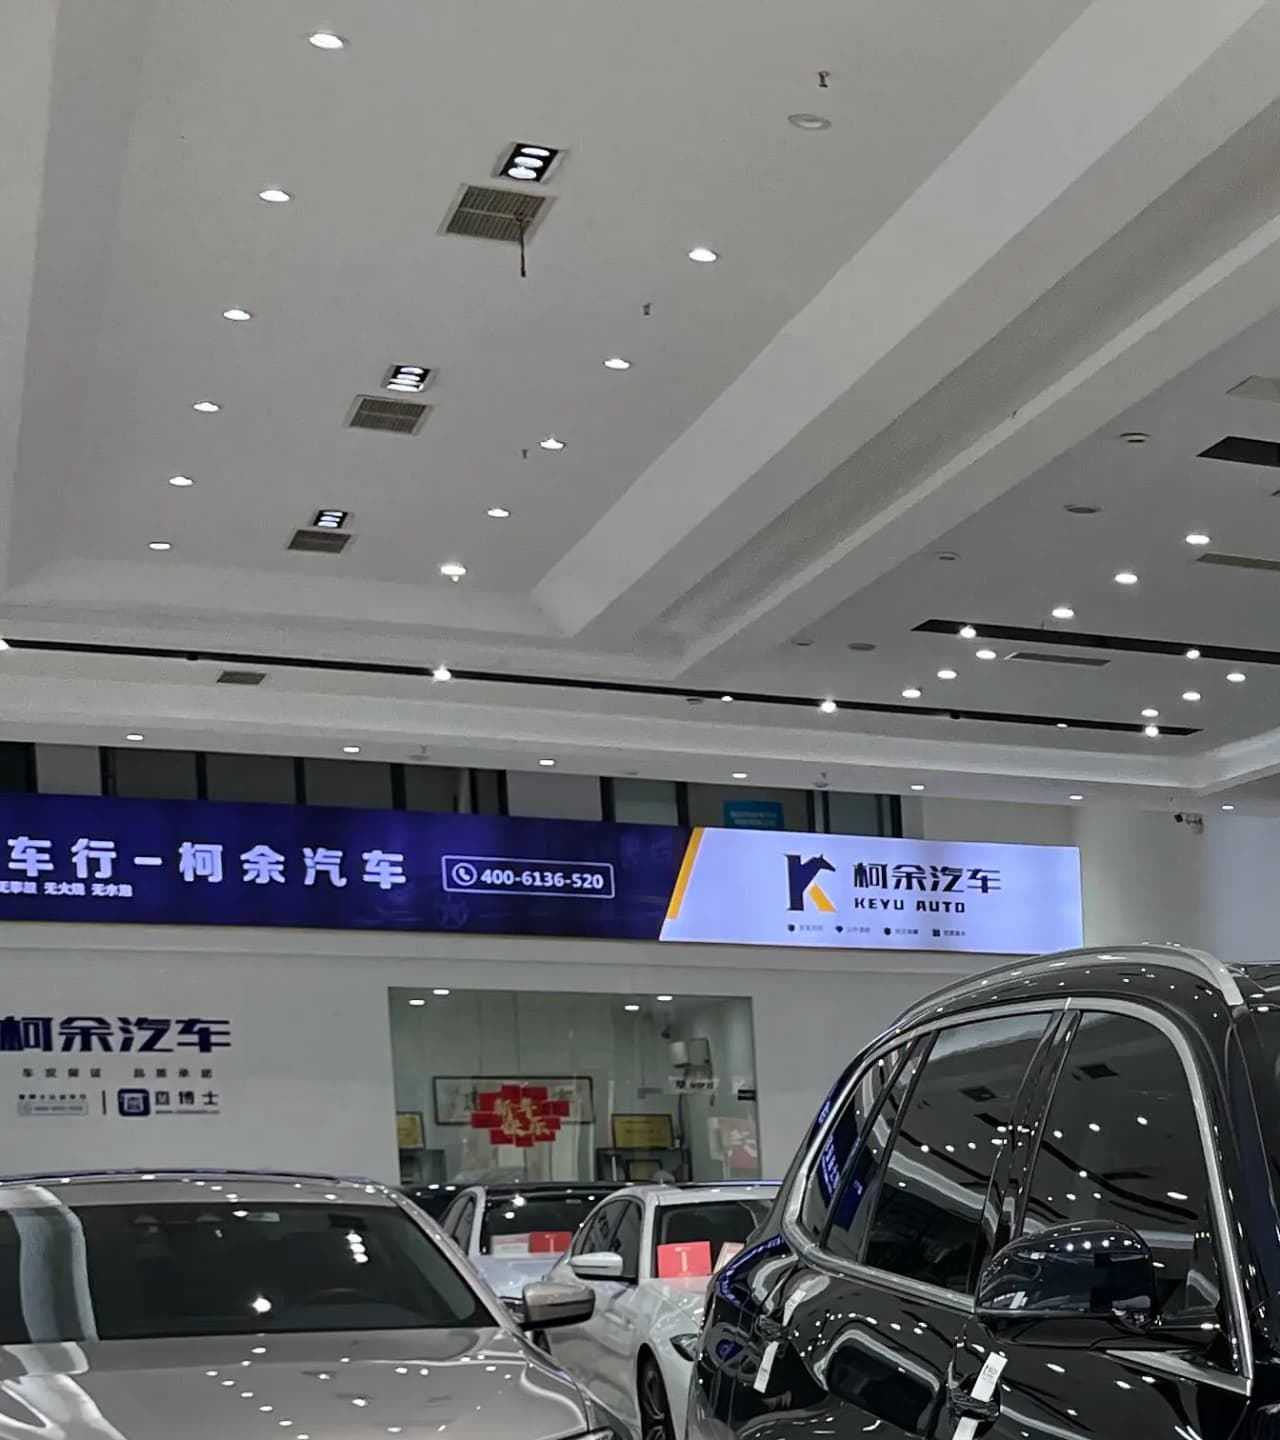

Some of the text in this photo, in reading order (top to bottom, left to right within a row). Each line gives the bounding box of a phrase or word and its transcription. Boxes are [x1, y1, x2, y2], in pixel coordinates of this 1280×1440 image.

[480, 869, 604, 889] 400-6136-520
[853, 861, 1001, 894] 柯余汽车
[855, 897, 966, 914] KEYU AUTO
[0, 1016, 232, 1053] 柯余汽车
